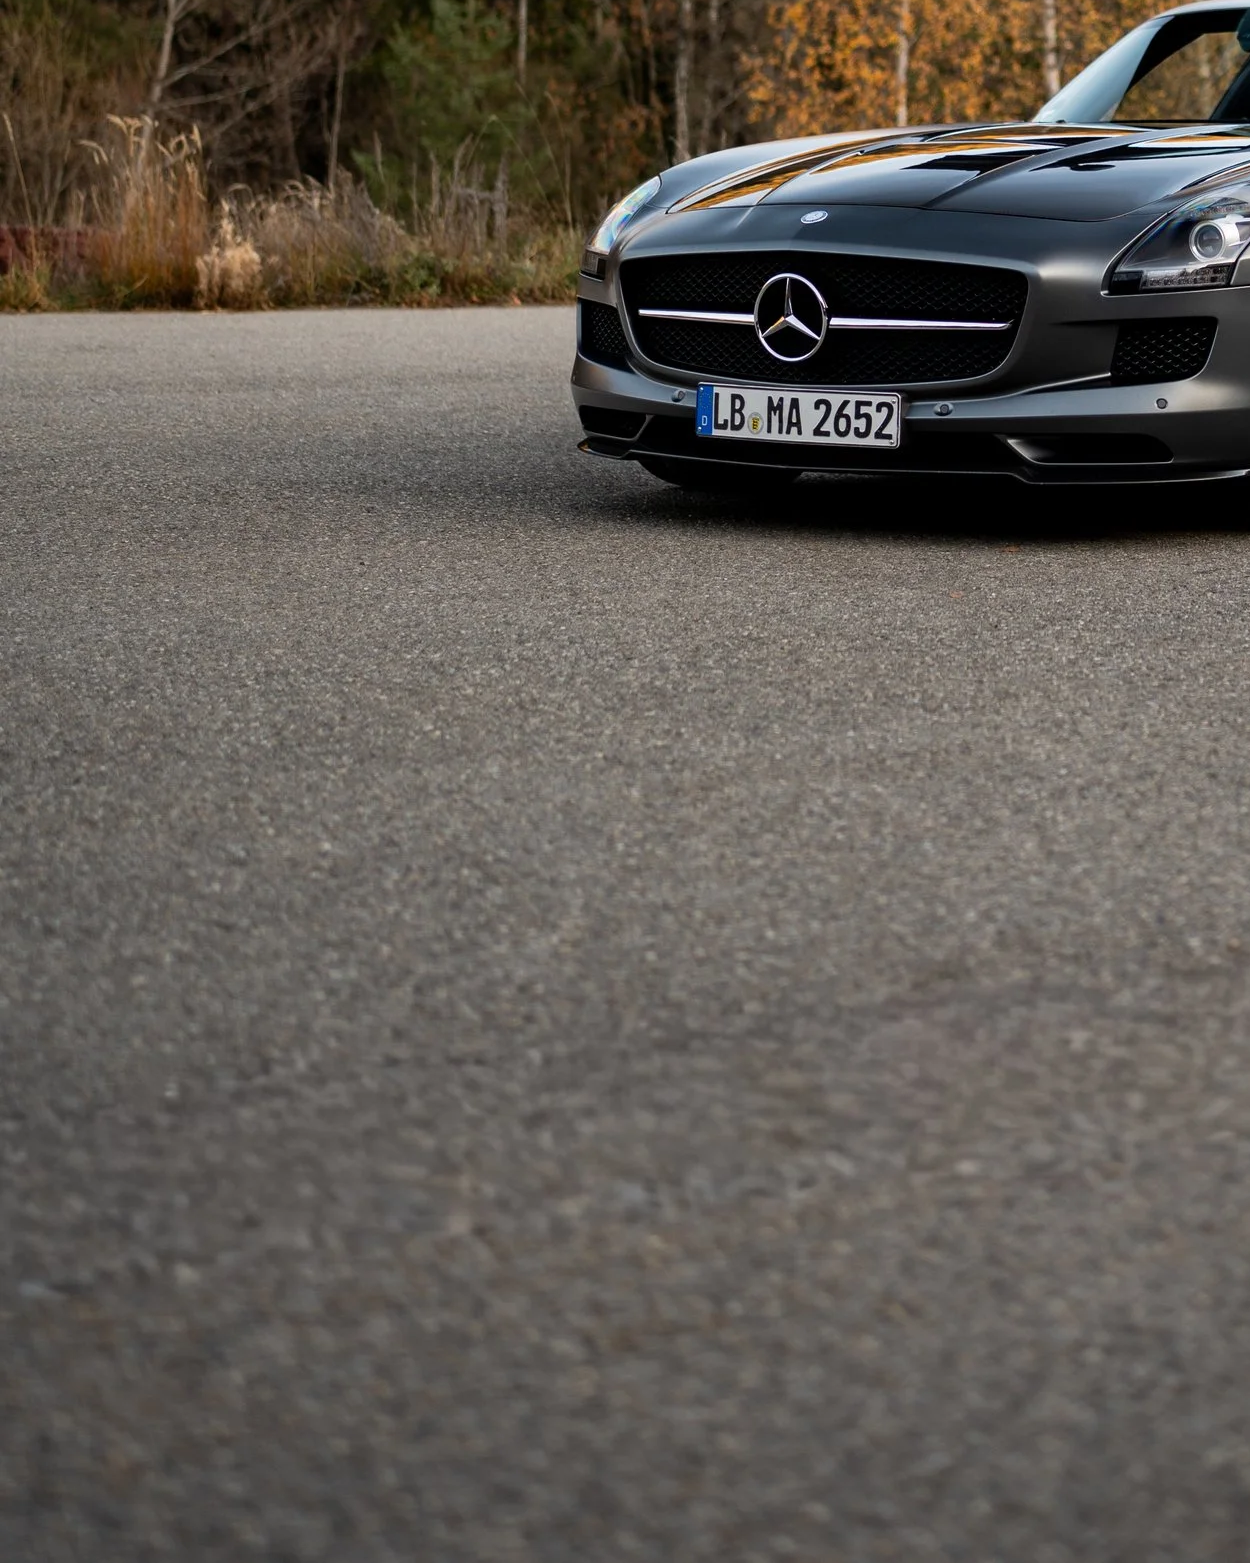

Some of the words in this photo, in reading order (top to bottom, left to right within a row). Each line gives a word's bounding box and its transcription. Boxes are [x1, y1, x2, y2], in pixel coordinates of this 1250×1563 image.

[702, 415, 708, 426] D
[713, 392, 745, 431] LB
[767, 395, 802, 436] MA
[813, 398, 894, 440] 2652
